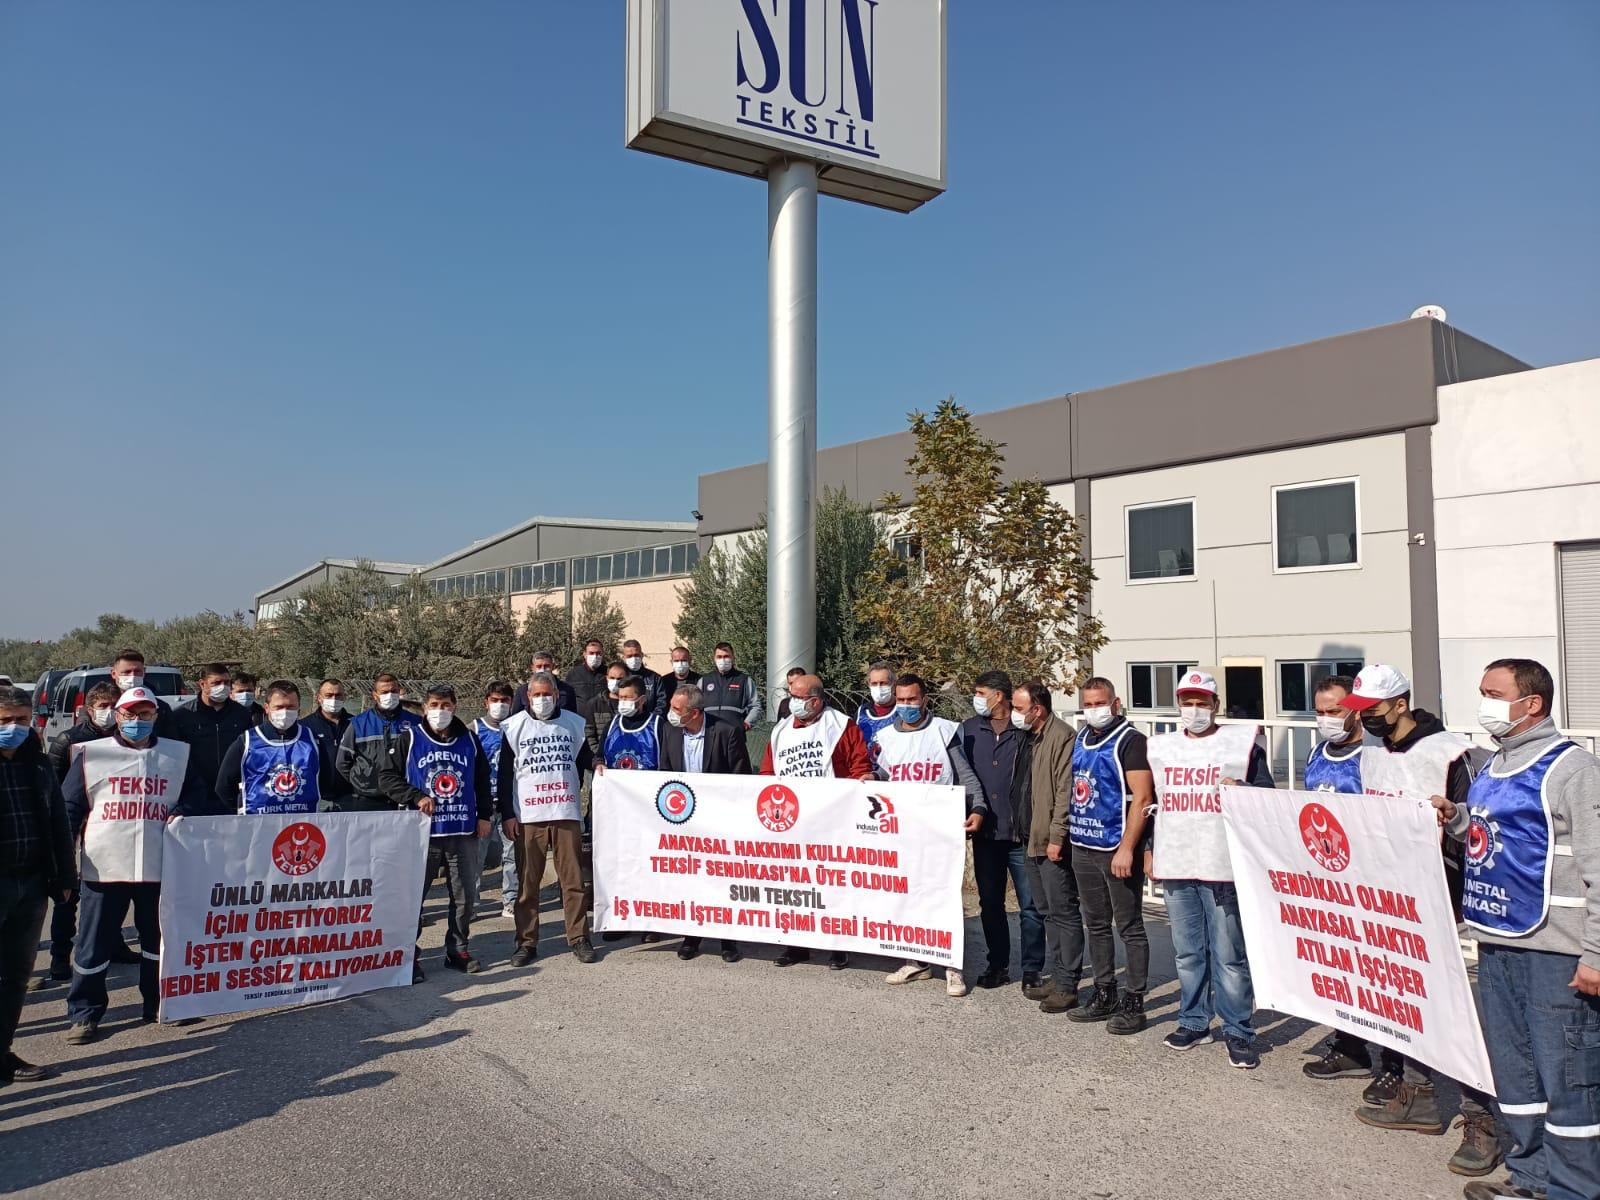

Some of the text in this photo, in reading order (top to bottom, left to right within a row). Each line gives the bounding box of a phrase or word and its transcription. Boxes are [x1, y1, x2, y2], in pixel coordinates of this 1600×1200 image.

[736, 0, 879, 122] SUN
[736, 95, 875, 150] TEKSTİL
[531, 744, 571, 755] OLMAK
[786, 750, 823, 764] OLMAK
[531, 763, 571, 774] HAKTIR
[780, 759, 822, 776] ANAYAS
[889, 758, 943, 782] EKSİF
[1164, 763, 1221, 785] TEKSİF
[108, 773, 168, 796] TEKSİF
[102, 796, 168, 822] SENDİKASI
[284, 803, 309, 811] METAL
[446, 804, 469, 812] META
[524, 793, 577, 806] SENDİKAS
[1162, 787, 1222, 813] SENDİKAS
[658, 833, 898, 869] ANAYASAL HAKKIMI KULLANDIM
[650, 854, 909, 894] TEKSİF SENDİKASI'NA ÜYE OLDUM
[210, 878, 373, 907] ÜNLÜ MARKALAR
[729, 884, 826, 909] SUN TEKSTİL
[1268, 869, 1422, 924] SENDİKALI OLMAK
[1467, 878, 1511, 901] METAL
[1462, 892, 1507, 917] DİKASI
[204, 903, 373, 939] İÇİN ÜRETİYORUZ
[613, 896, 952, 950] İŞ VERENİ İŞTEN ATTI İŞİMİ GERİ İSTİYORUM
[1279, 901, 1431, 963] ANAYASAL HAKTIR
[184, 928, 383, 969] İŞTEN ÇIKARMALARA
[225, 960, 294, 990] SESSİZ
[299, 949, 404, 981] KALIYORLAR
[1296, 936, 1428, 999] ATILAN İŞÇİŞER
[1311, 972, 1424, 1034] GERİ ALINSIN
